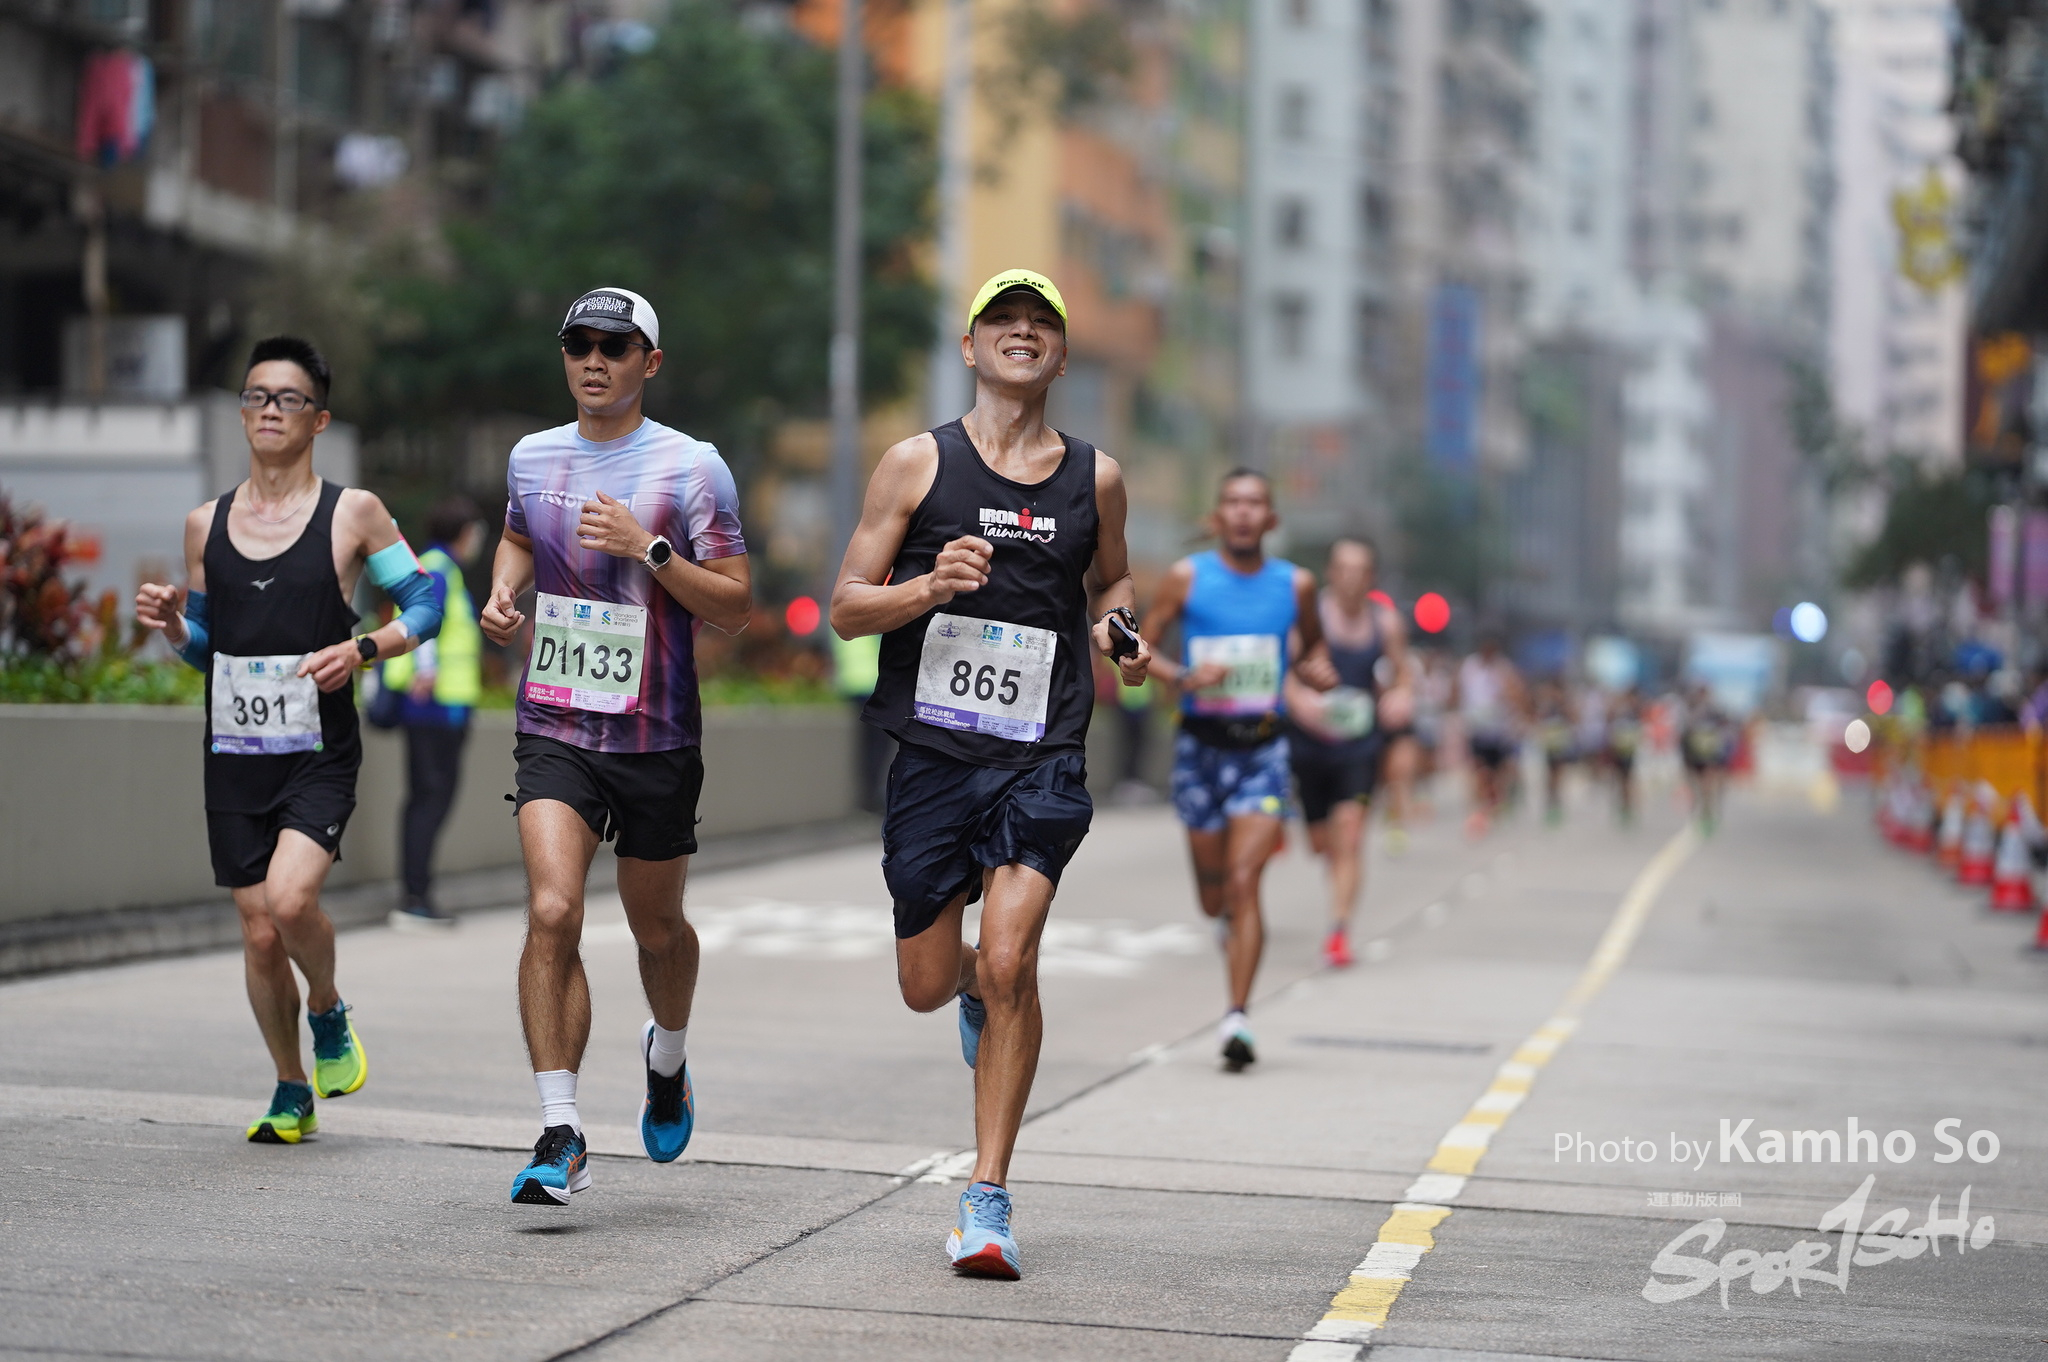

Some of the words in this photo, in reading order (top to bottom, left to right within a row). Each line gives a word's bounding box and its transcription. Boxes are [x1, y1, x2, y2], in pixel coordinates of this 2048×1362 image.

[979, 523, 1047, 543] Taiwan
[536, 636, 633, 683] D1133
[949, 660, 1021, 706] 865
[233, 694, 286, 726] 391
[917, 712, 943, 723] Marathon
[943, 717, 971, 729] Challenge
